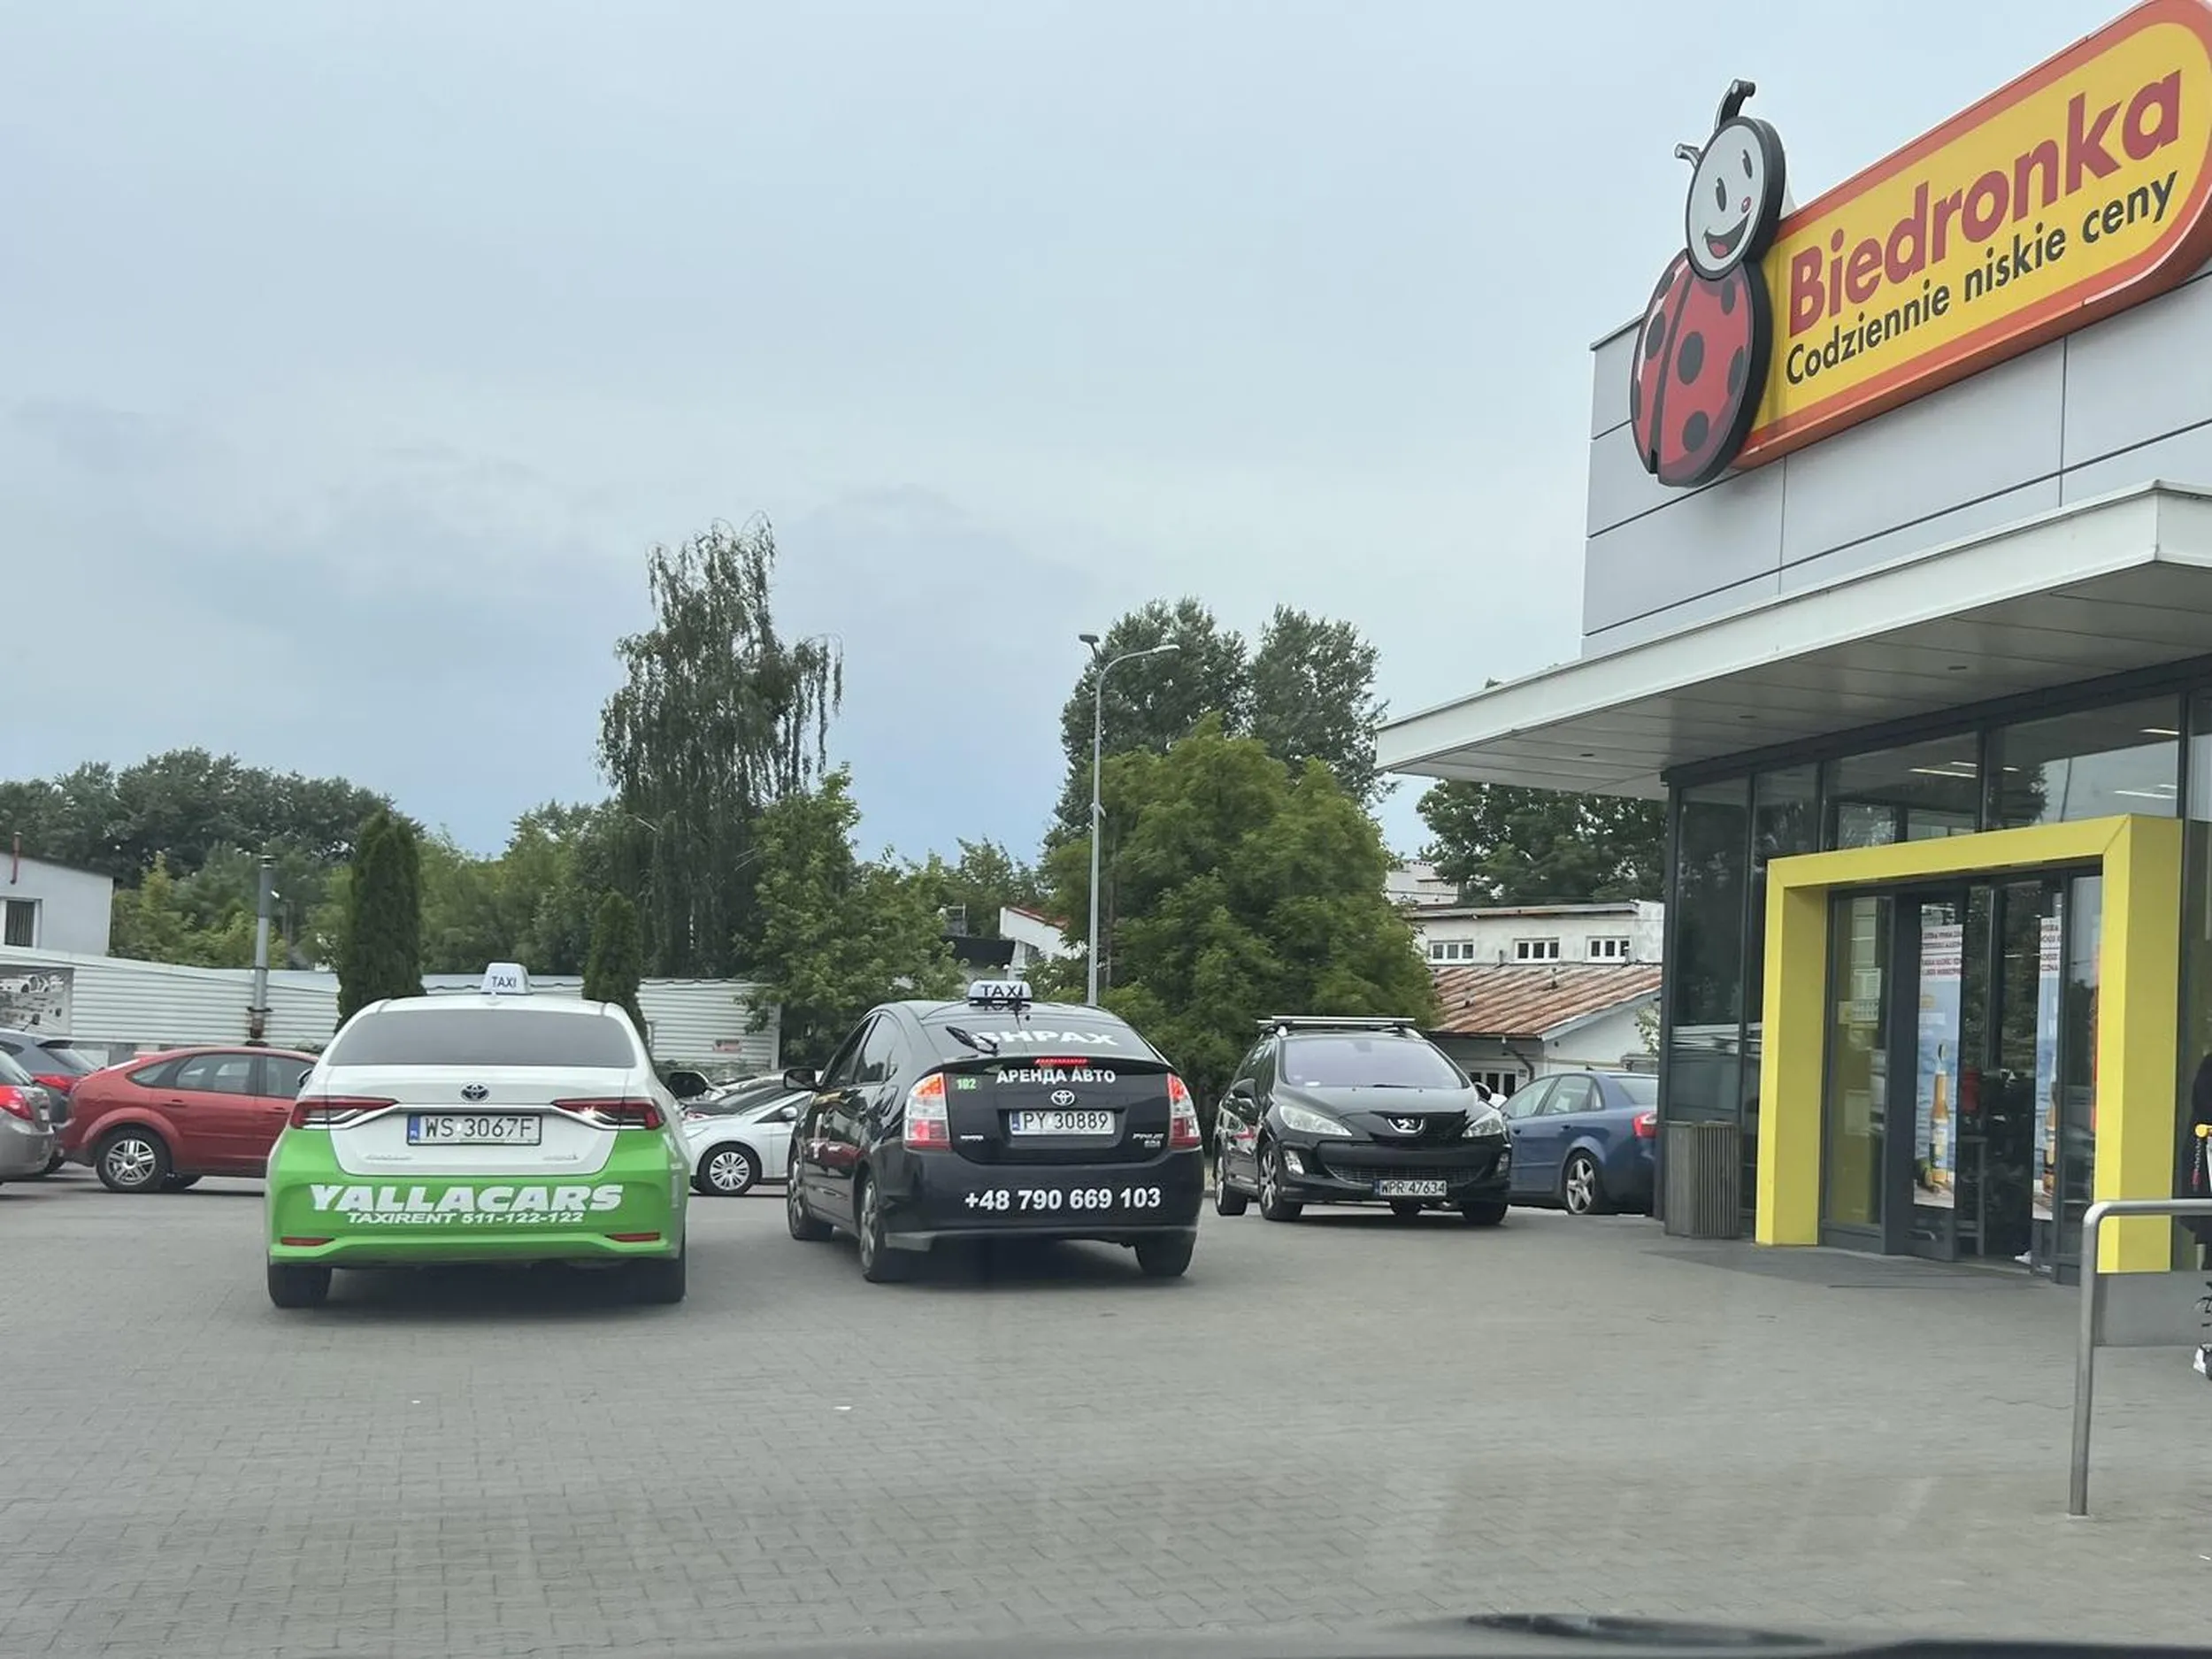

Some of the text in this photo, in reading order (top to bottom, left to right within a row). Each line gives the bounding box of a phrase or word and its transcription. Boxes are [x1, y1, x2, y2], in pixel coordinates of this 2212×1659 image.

[1790, 70, 2181, 338] Biedronka
[1786, 171, 2177, 384] Codziennie niskie ceny
[492, 976, 517, 987] TAXI
[980, 984, 1023, 996] TAXI
[996, 1069, 1116, 1084] АРЕНДА АВТО
[426, 1118, 534, 1138] WS 3067F
[1024, 1112, 1109, 1129] PY 30889
[310, 1184, 623, 1212] YALLACARS
[964, 1187, 1161, 1210] +48 790 669 103
[347, 1211, 584, 1225] TAXIRENT 511-122-122
